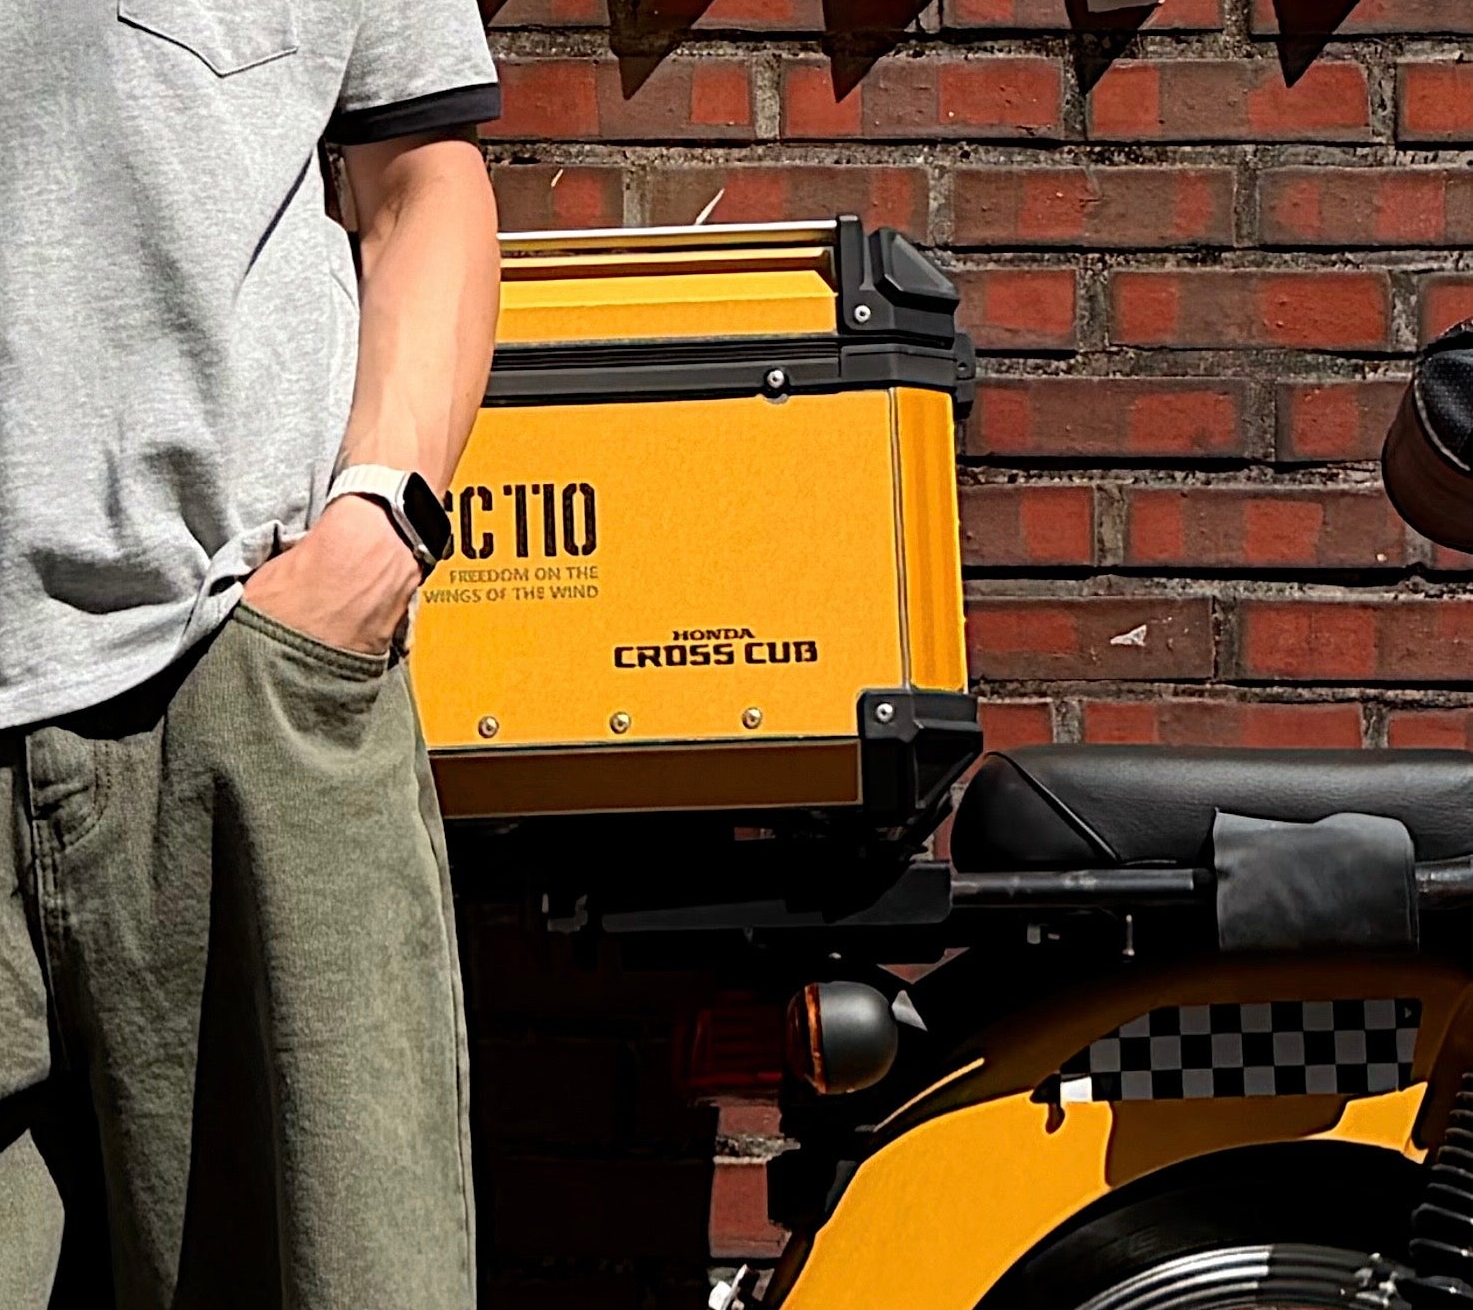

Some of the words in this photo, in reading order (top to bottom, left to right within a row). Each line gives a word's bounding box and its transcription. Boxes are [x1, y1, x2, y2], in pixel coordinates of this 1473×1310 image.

[449, 568, 529, 584] FREEDOM
[534, 566, 561, 581] ON
[565, 565, 599, 580] THE
[423, 588, 482, 604] WINGS
[486, 587, 507, 602] OF
[511, 586, 545, 601] THE
[549, 584, 599, 600] WIND
[672, 628, 756, 641] HONDA
[614, 643, 735, 668] CROSS
[744, 641, 818, 665] CUB
